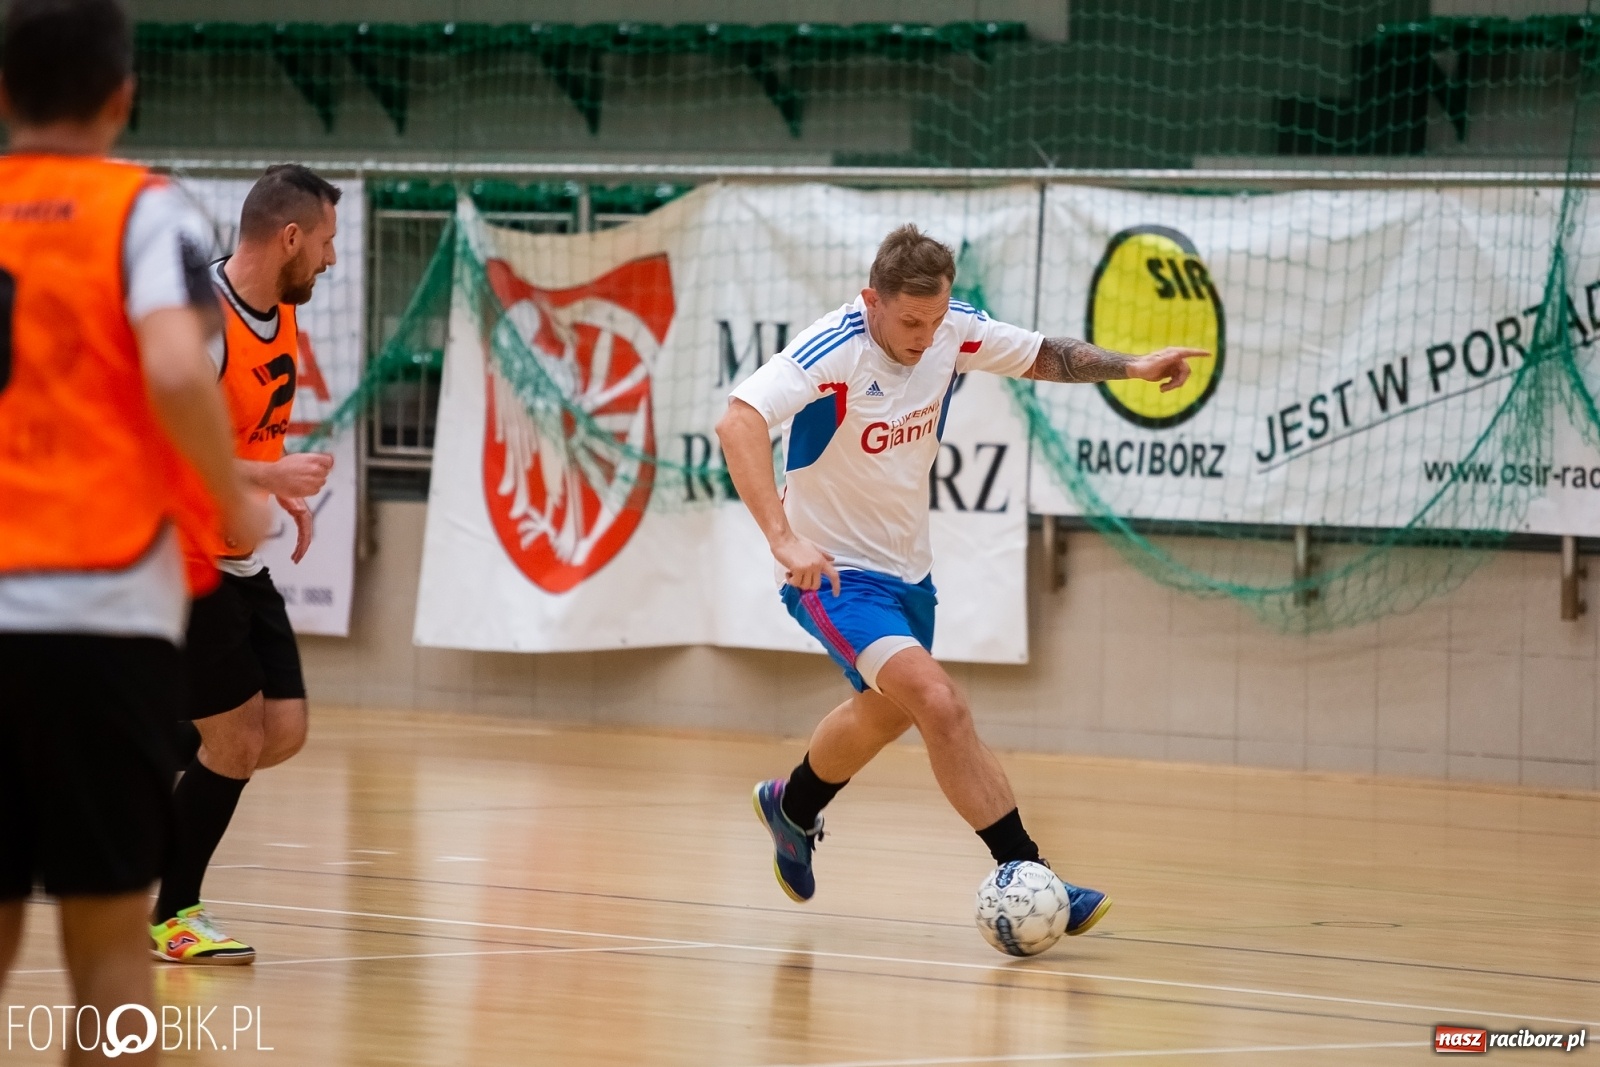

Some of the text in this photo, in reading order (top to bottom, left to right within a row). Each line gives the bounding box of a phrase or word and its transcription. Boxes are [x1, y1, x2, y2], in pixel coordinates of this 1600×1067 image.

[1257, 379, 1354, 464] JEST
[1367, 355, 1409, 412] W
[1076, 432, 1227, 479] RACIBÓRZ
